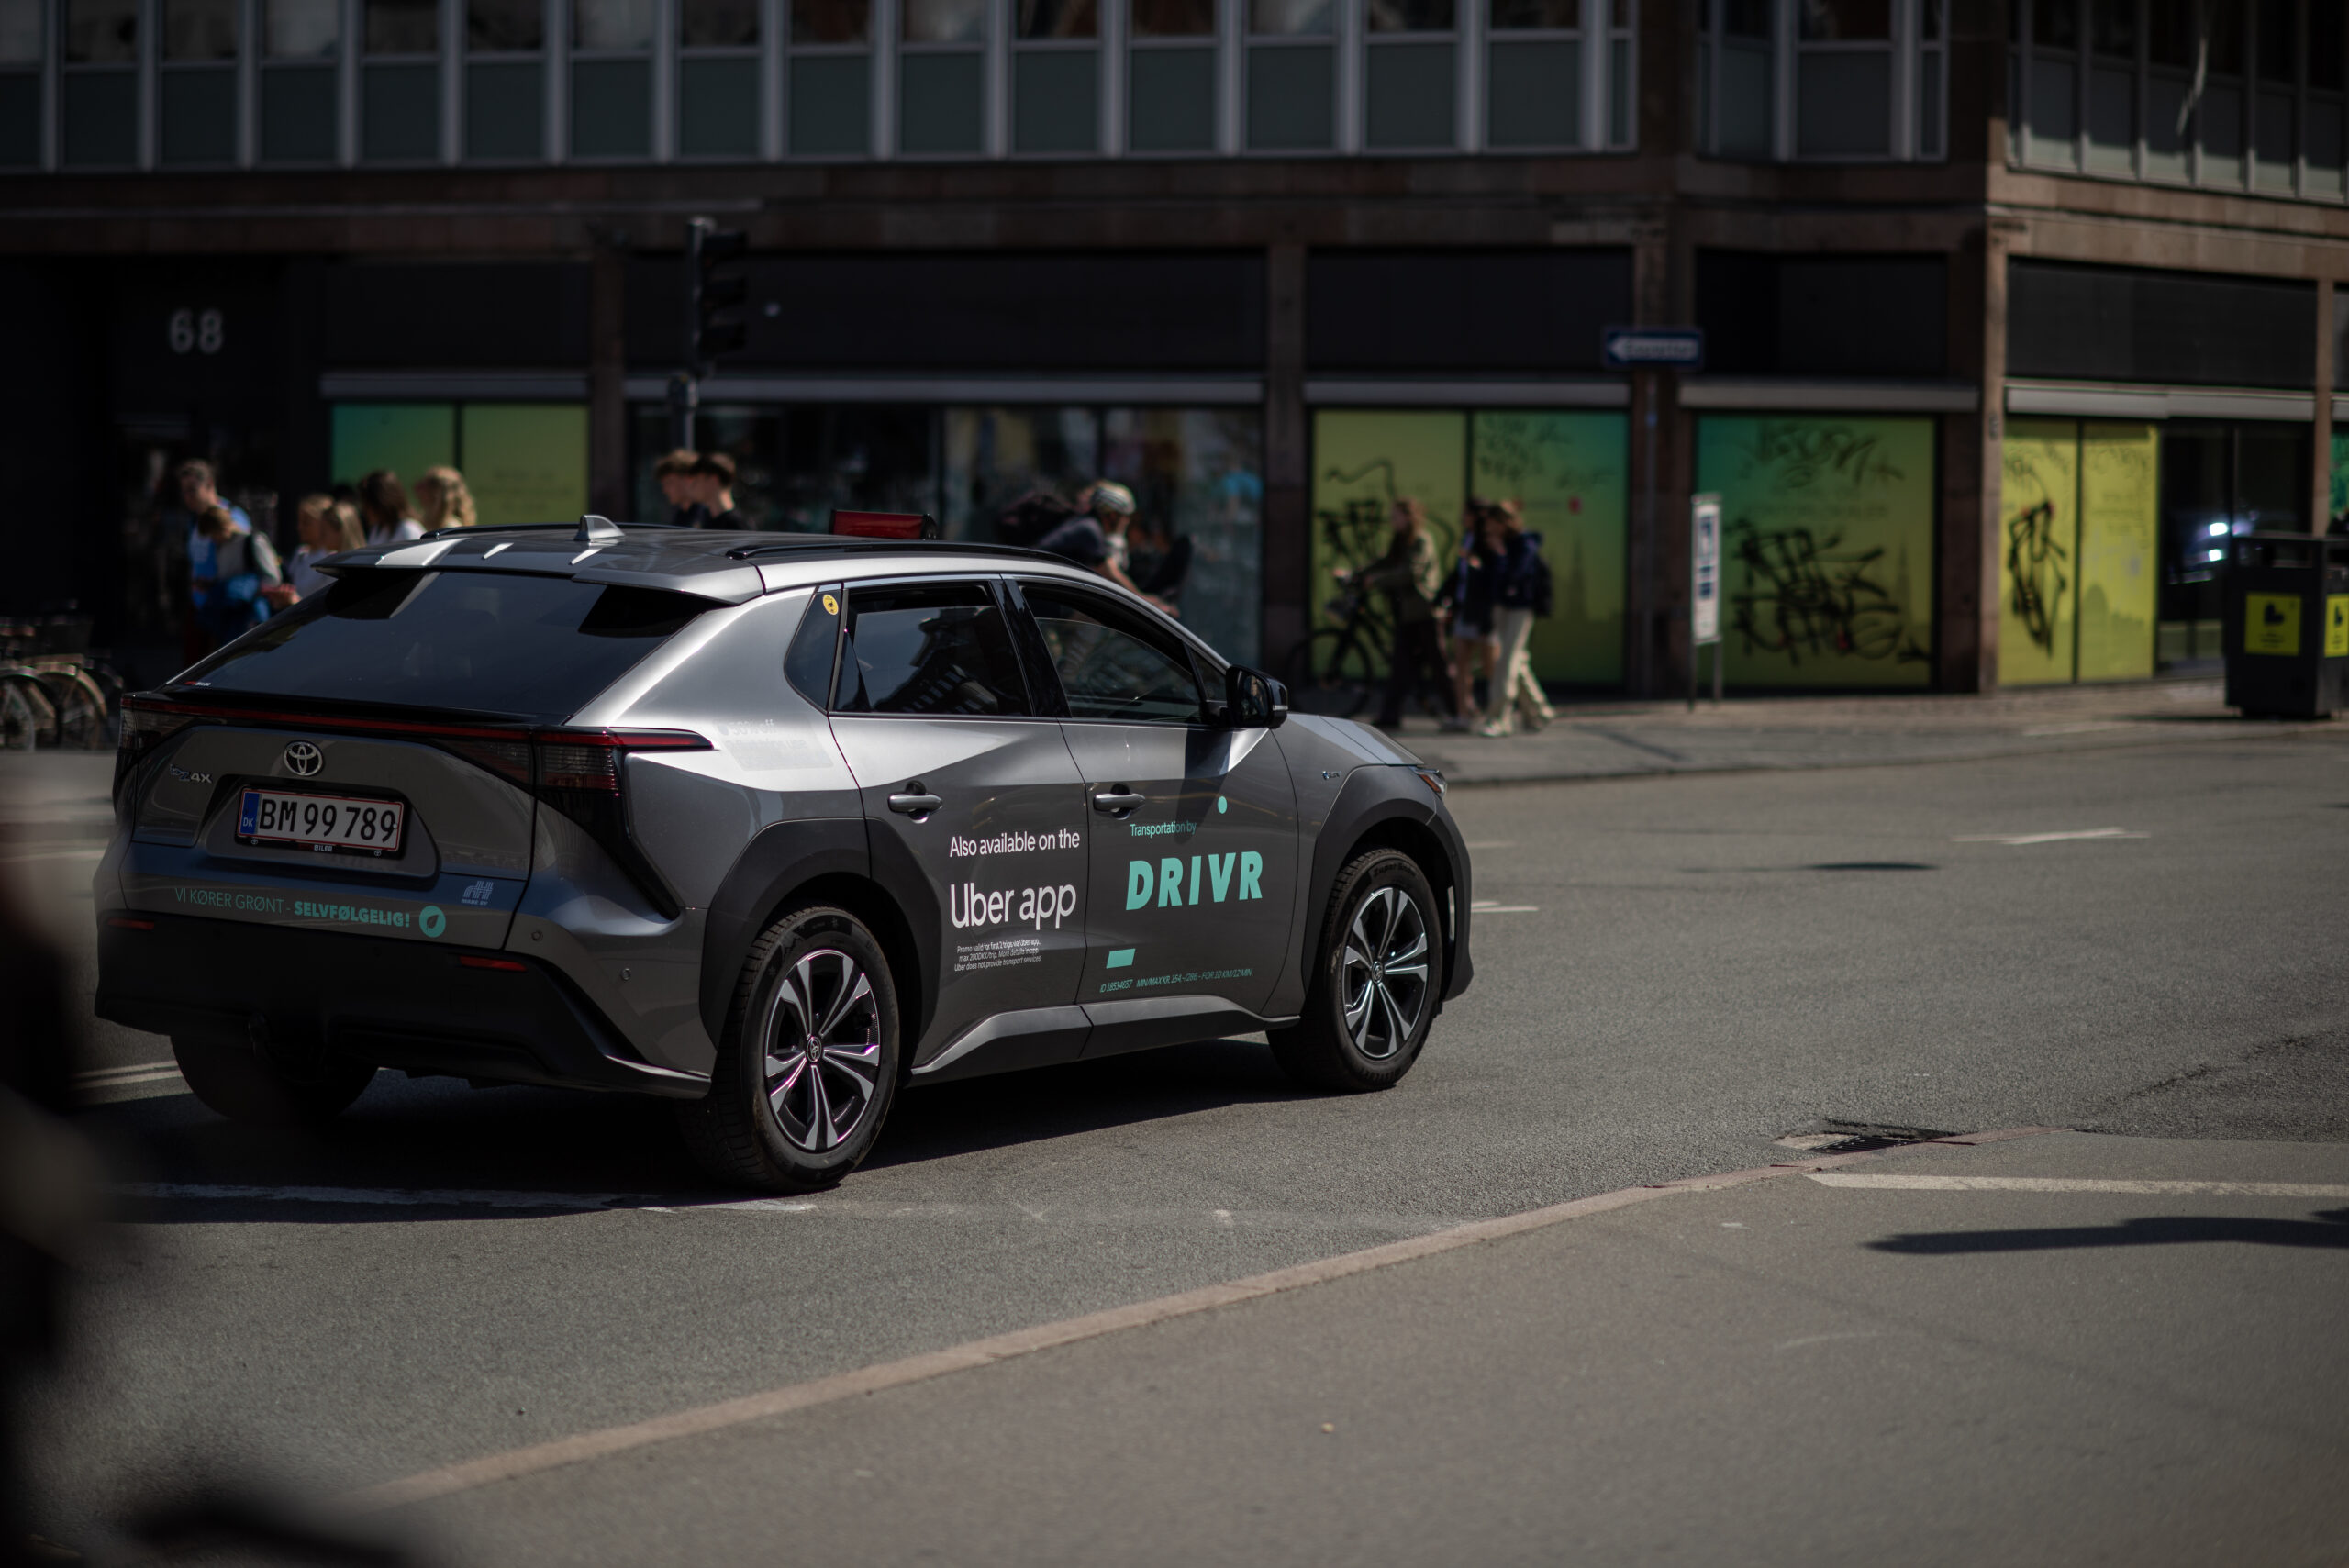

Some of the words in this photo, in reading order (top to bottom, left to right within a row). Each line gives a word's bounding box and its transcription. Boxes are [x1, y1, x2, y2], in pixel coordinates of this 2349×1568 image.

[167, 306, 224, 355] 68
[242, 817, 254, 828] DK
[259, 799, 297, 832] BM
[304, 803, 337, 837] 99
[344, 806, 395, 843] 789
[1130, 821, 1186, 839] Transportation
[1186, 819, 1197, 834] by
[950, 835, 977, 858] Also
[979, 831, 1036, 855] available
[1038, 833, 1056, 851] on
[1058, 828, 1080, 849] the
[1125, 851, 1264, 911] DRIVR
[175, 887, 186, 904] VI
[190, 889, 232, 907] KØRER
[294, 900, 410, 928] SELVFØLGELIG!
[950, 882, 1015, 929] Uber
[1019, 884, 1077, 931] app
[956, 945, 973, 954] Promo
[973, 943, 984, 951] valid
[1019, 939, 1030, 947] Uber
[954, 963, 966, 972] Uber
[966, 962, 977, 971] does
[1099, 984, 1107, 993] ID
